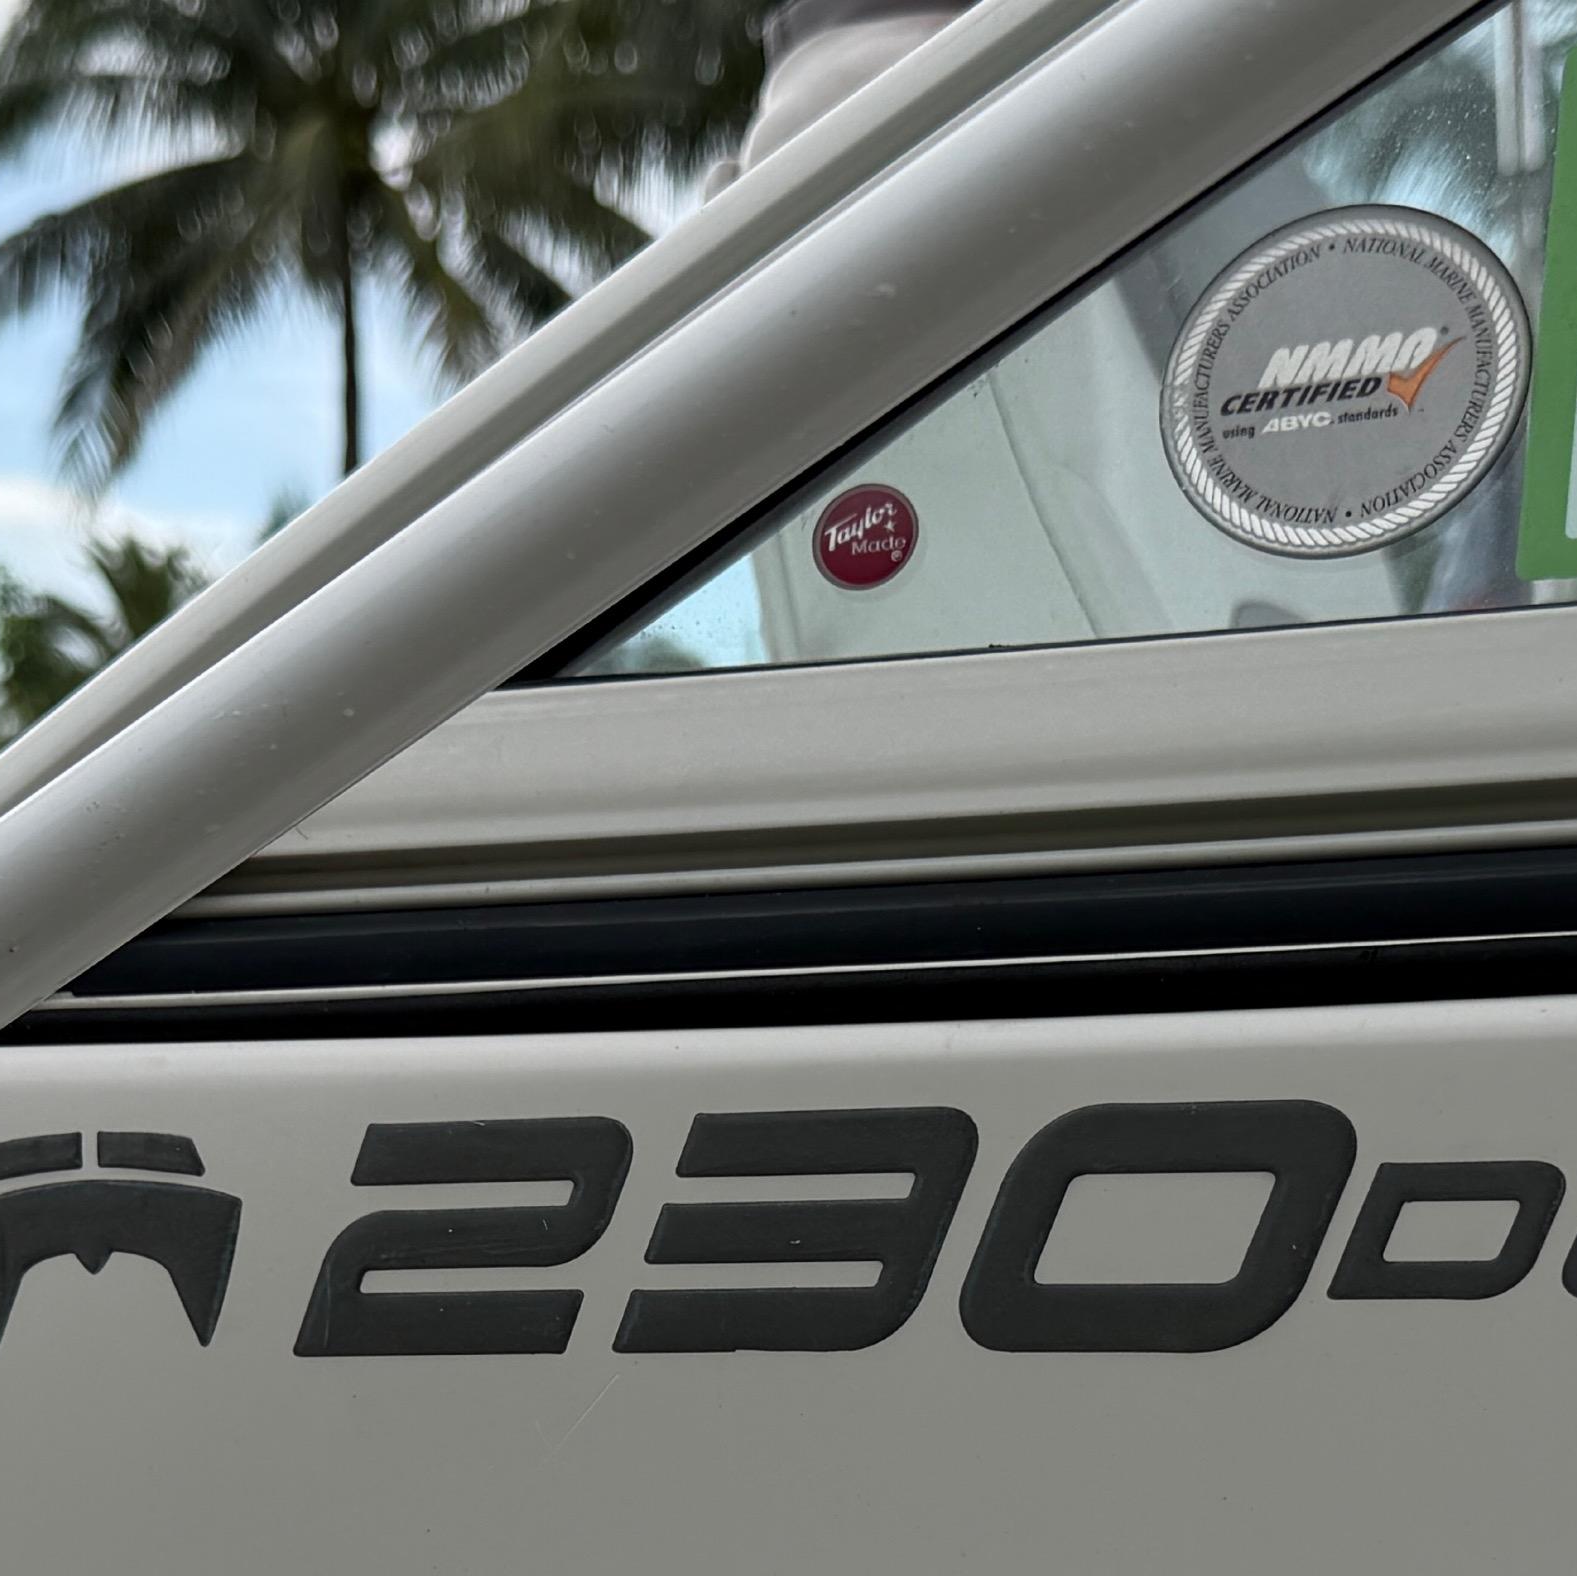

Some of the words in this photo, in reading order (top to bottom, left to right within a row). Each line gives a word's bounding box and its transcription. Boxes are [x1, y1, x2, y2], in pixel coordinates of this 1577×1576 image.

[1343, 237, 1425, 265] NATIONAL
[1227, 243, 1322, 321] ASSOCIATION
[1424, 256, 1477, 304] MARINE
[1192, 319, 1230, 454] MANUFACTURERS
[1220, 376, 1382, 416] CERTIFIED
[1454, 304, 1493, 443] MANUFACTURERS
[1222, 425, 1256, 440] using
[1338, 403, 1399, 424] standards
[1207, 454, 1259, 503] MARINE
[1360, 440, 1457, 518] ASSOCIATION
[824, 503, 898, 552] Taylor
[1256, 495, 1338, 524] NATIONAL
[851, 536, 906, 555] Made
